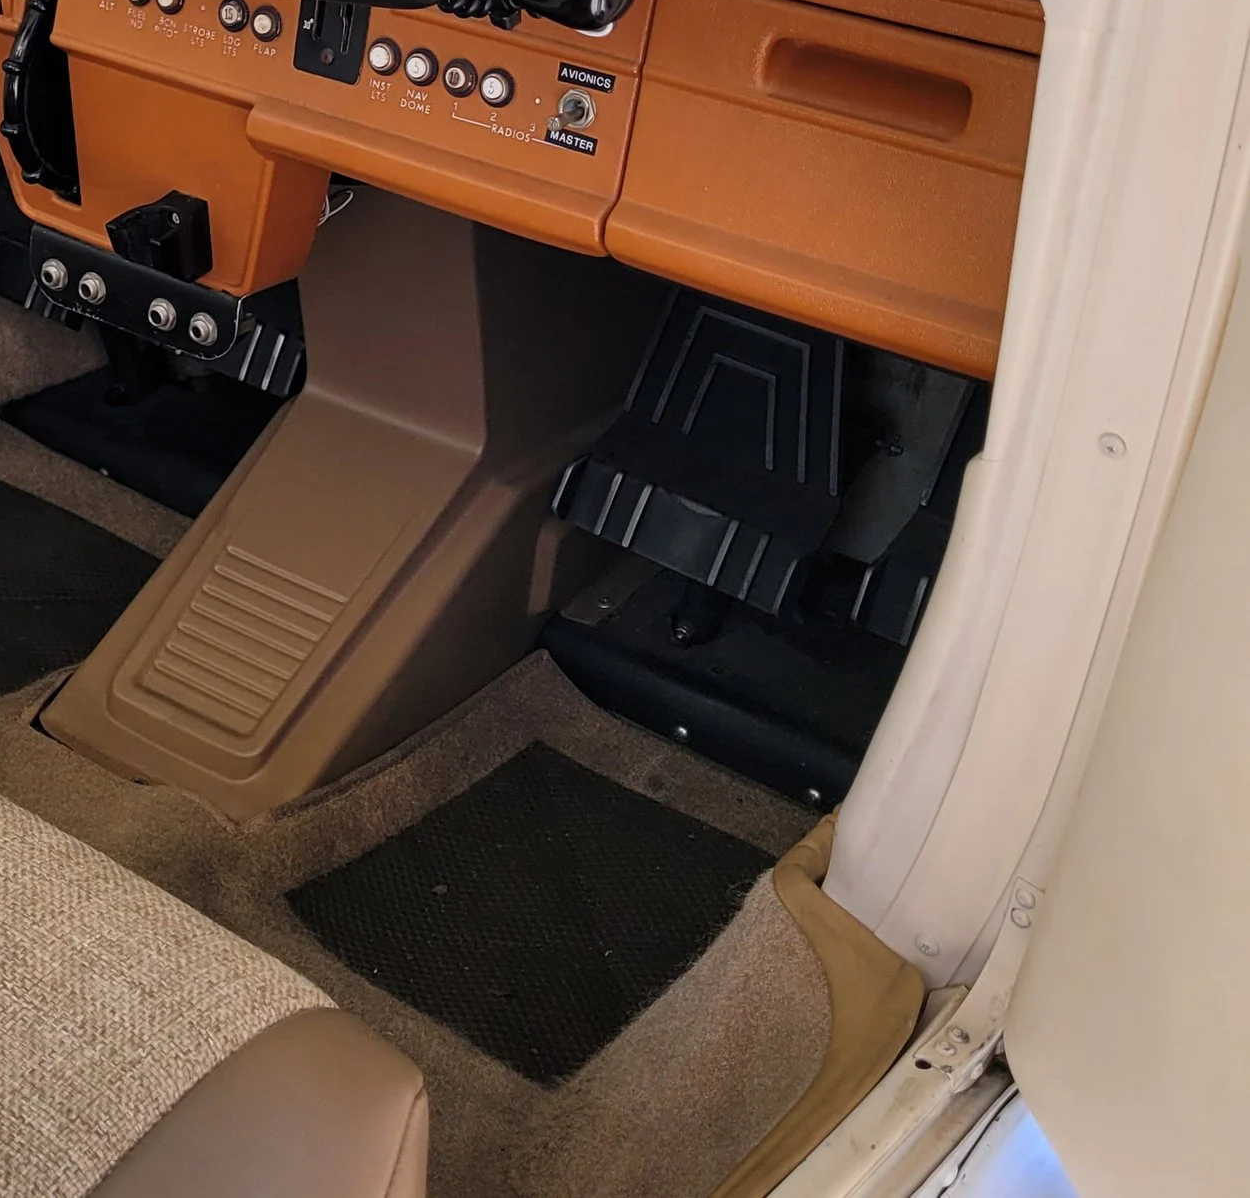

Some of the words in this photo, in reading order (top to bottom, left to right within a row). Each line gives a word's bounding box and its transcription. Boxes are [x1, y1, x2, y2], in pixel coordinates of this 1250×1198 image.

[183, 24, 216, 41] STROBE
[254, 44, 276, 57] FLAP
[369, 78, 391, 91] INST
[561, 68, 612, 88] AVIONICS
[407, 89, 428, 101] NAV
[400, 98, 430, 114] DOME
[490, 124, 530, 142] RADIOS
[550, 132, 593, 151] MASTER
